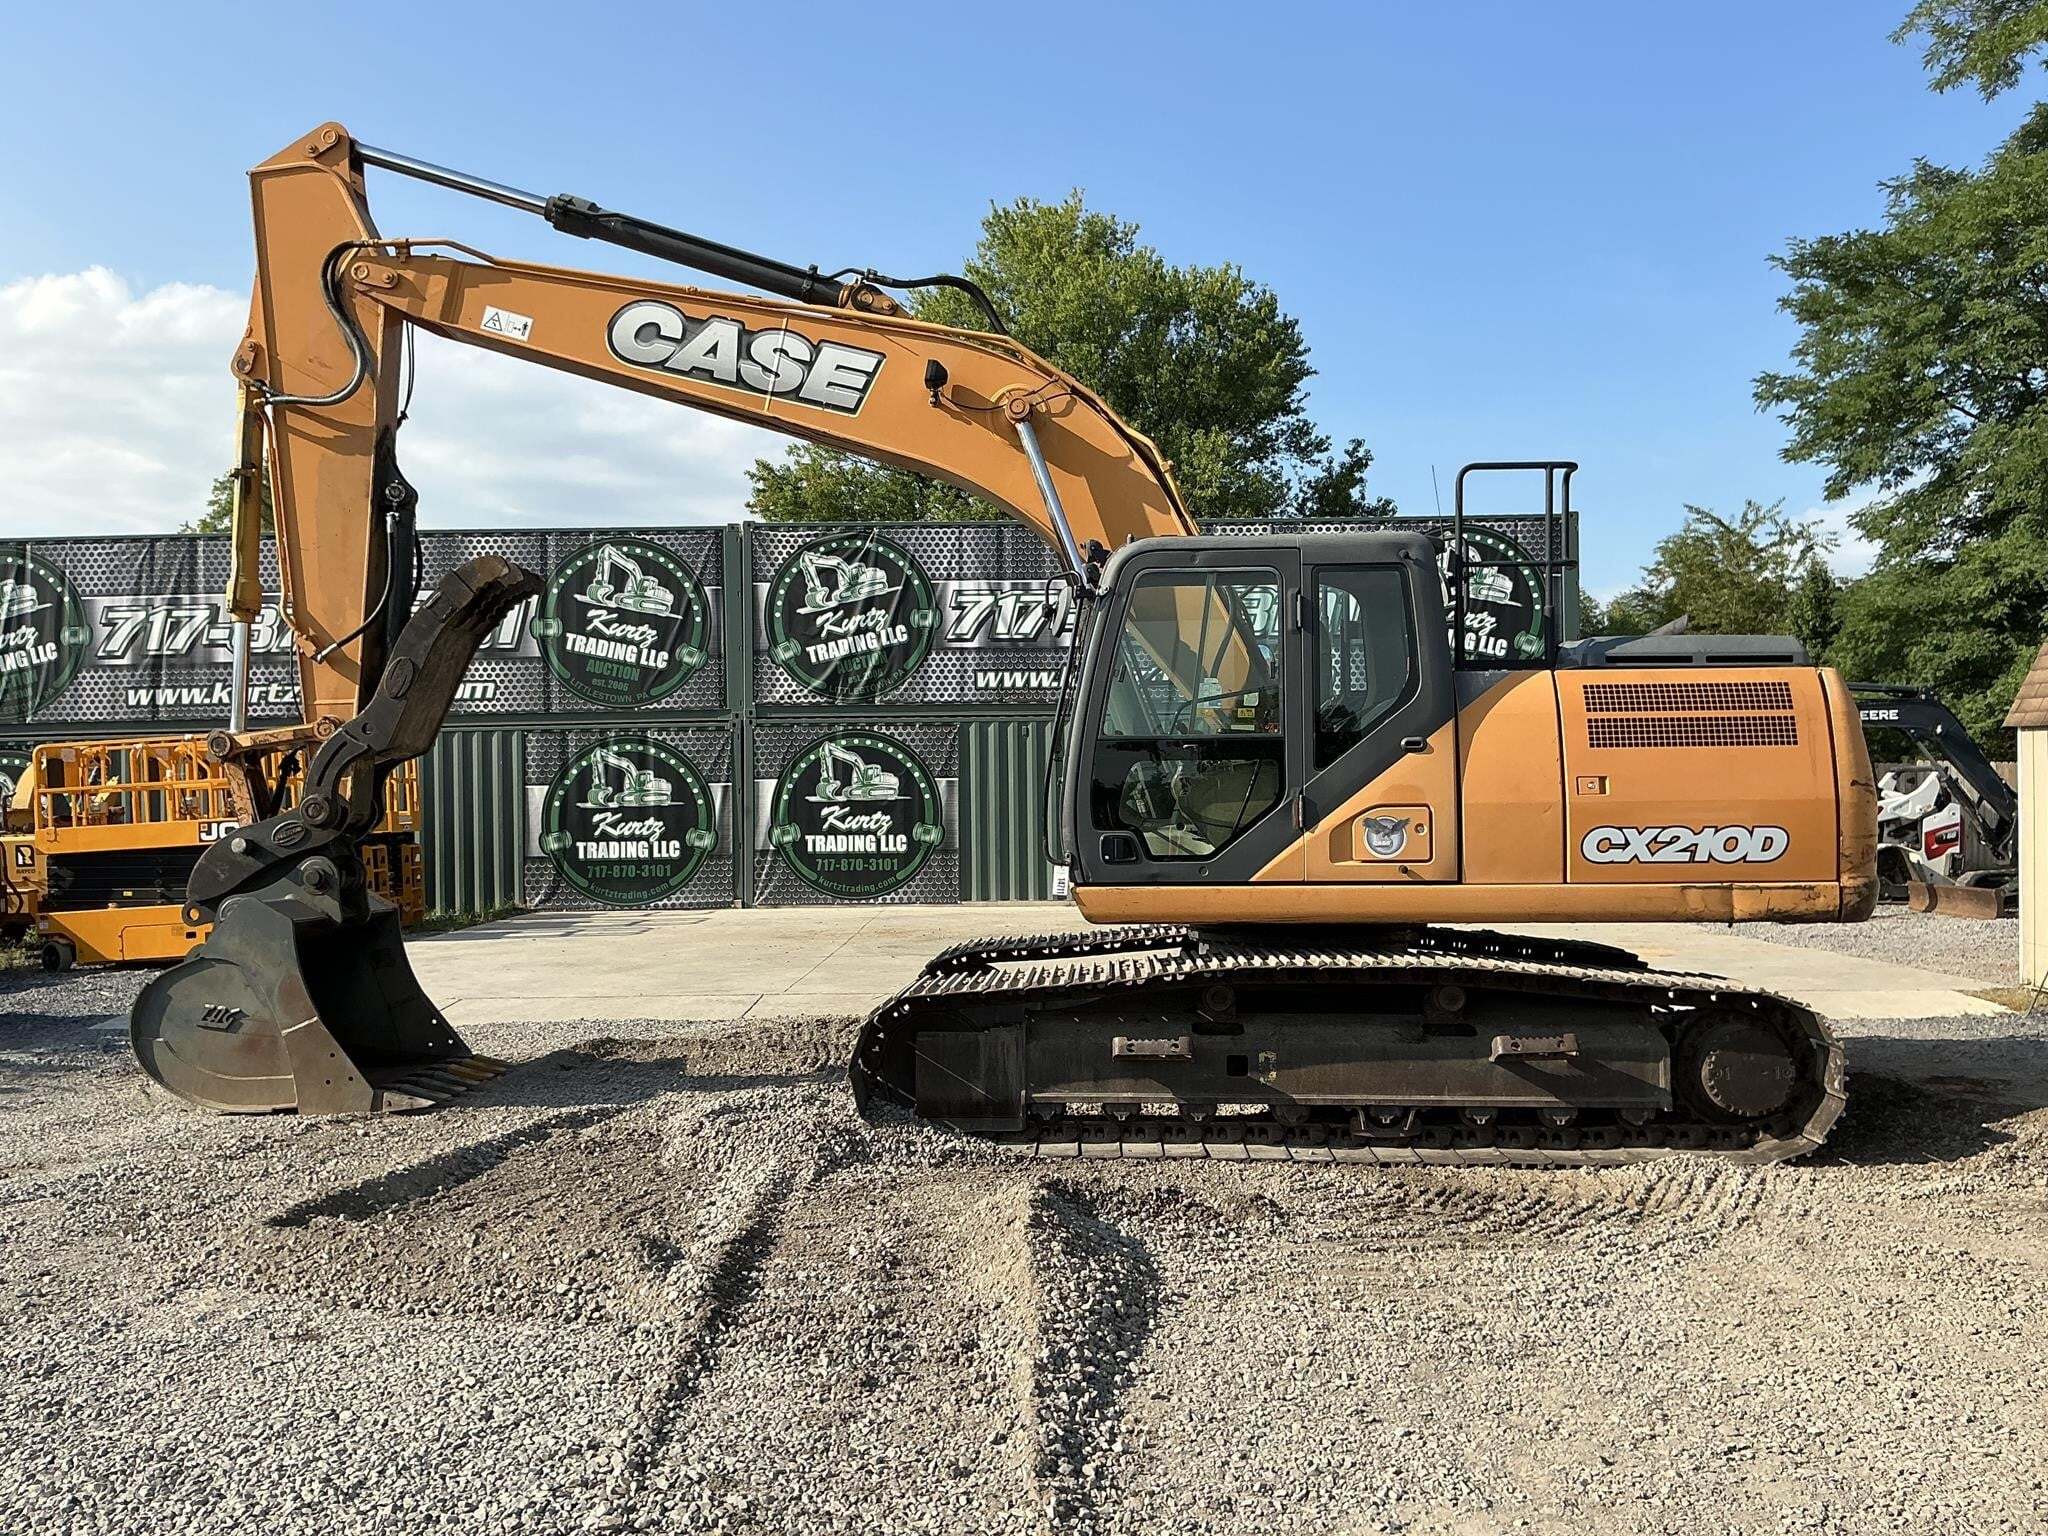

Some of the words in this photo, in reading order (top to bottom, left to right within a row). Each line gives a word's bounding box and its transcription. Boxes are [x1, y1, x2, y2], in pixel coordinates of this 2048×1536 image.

[608, 299, 882, 412] CASE
[586, 609, 658, 648] Kurtz
[816, 606, 889, 637] Kurtz
[30, 642, 58, 664] LLC
[565, 633, 638, 662] TRADING
[640, 647, 669, 669] LLC
[806, 632, 880, 664] TRADING
[880, 625, 908, 646] LLC
[1479, 635, 1508, 657] LLC
[586, 660, 640, 681] AUCTION
[1860, 709, 1899, 720] EERE
[200, 821, 240, 841] JC
[592, 811, 665, 840] Kurtz
[820, 805, 893, 835] Kurtz
[576, 840, 649, 859] TRADING
[653, 840, 681, 858] LLC
[805, 834, 877, 853] TRADING
[879, 834, 908, 852] LLC
[1581, 825, 1789, 863] CX210D
[587, 864, 671, 878] 717-870-3101
[816, 858, 898, 872] 717-870-3101
[590, 881, 670, 900] kurtztrading.com
[817, 876, 897, 894] kurtztrading.com
